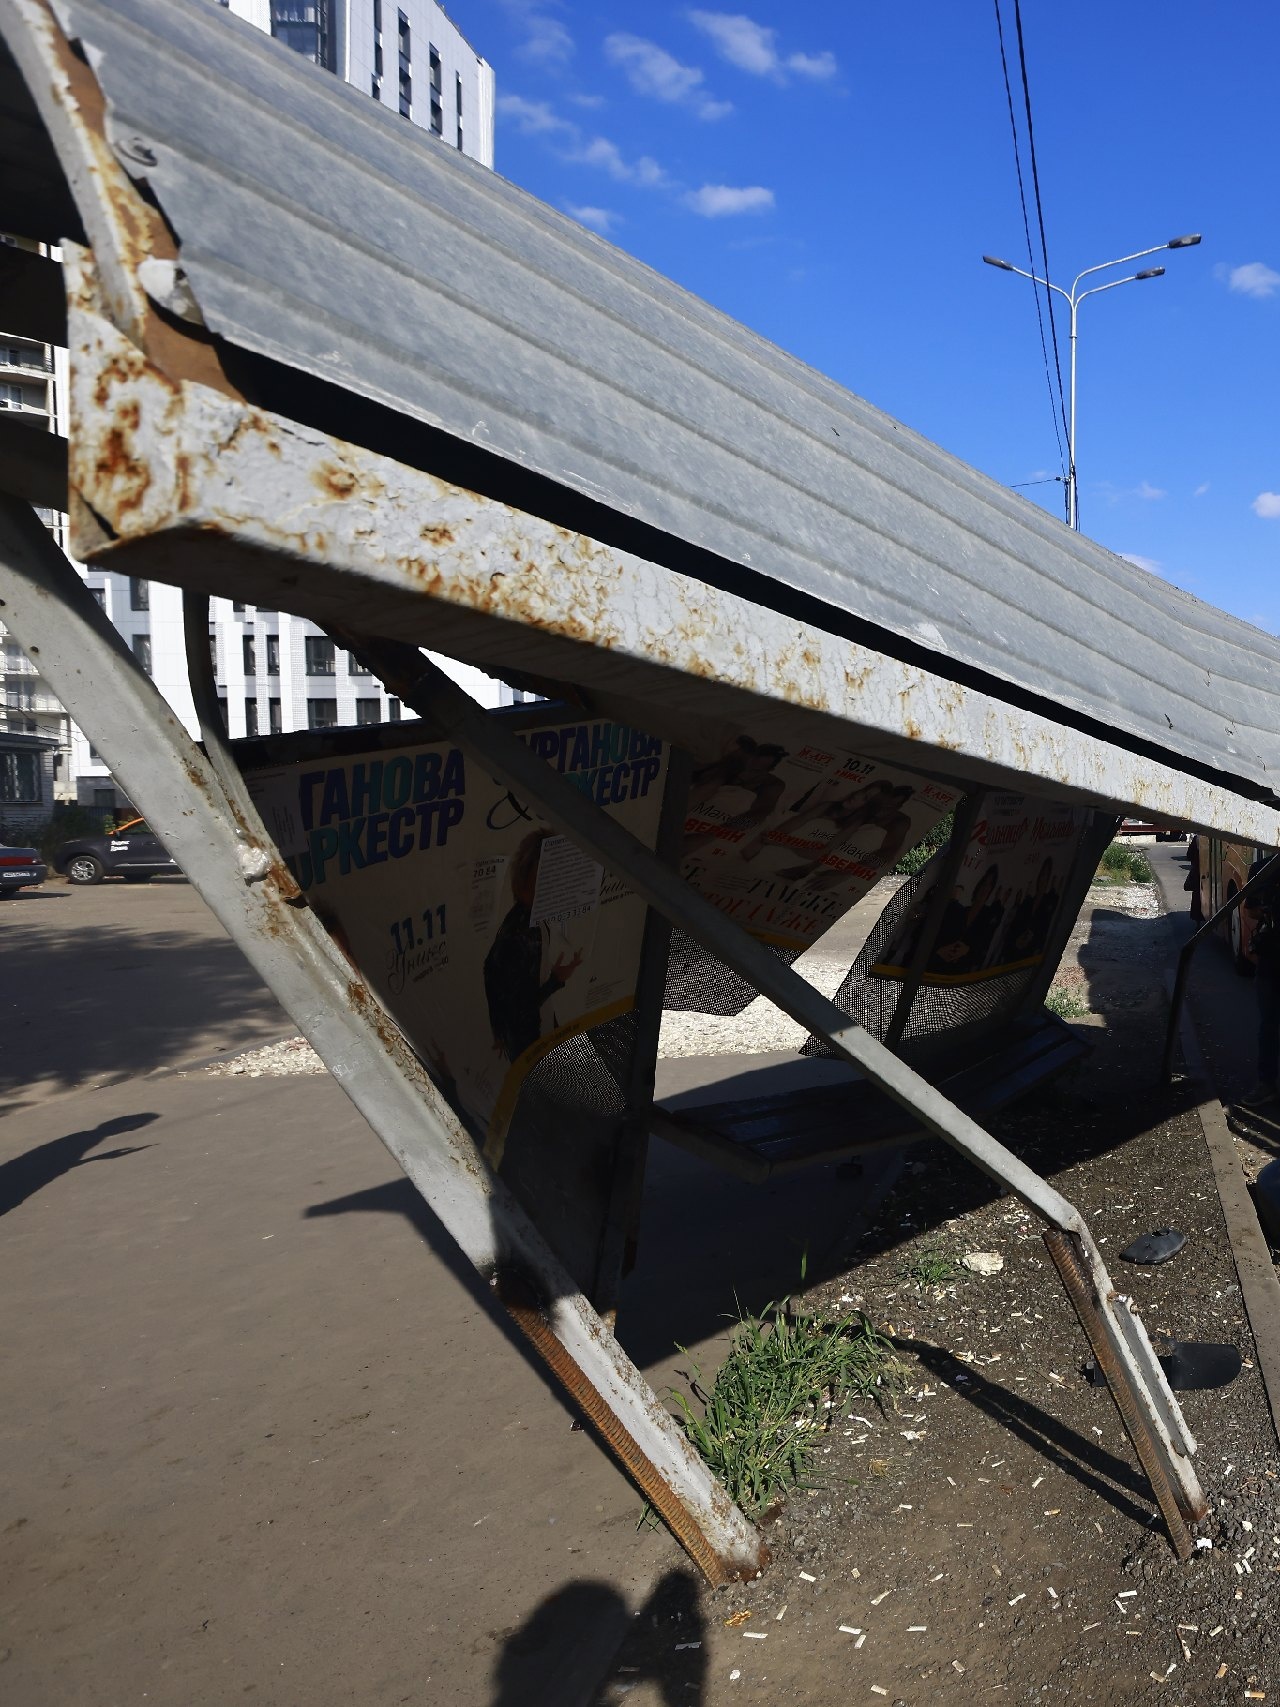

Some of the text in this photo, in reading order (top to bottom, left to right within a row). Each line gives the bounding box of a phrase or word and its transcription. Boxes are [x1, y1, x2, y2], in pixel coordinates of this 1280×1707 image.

[519, 723, 662, 773] УРГАНОВА
[299, 749, 466, 831] ГАНОВА
[562, 757, 661, 806] КЕСТР
[684, 817, 746, 843] ВЕРИН
[390, 904, 447, 954] 11.11
